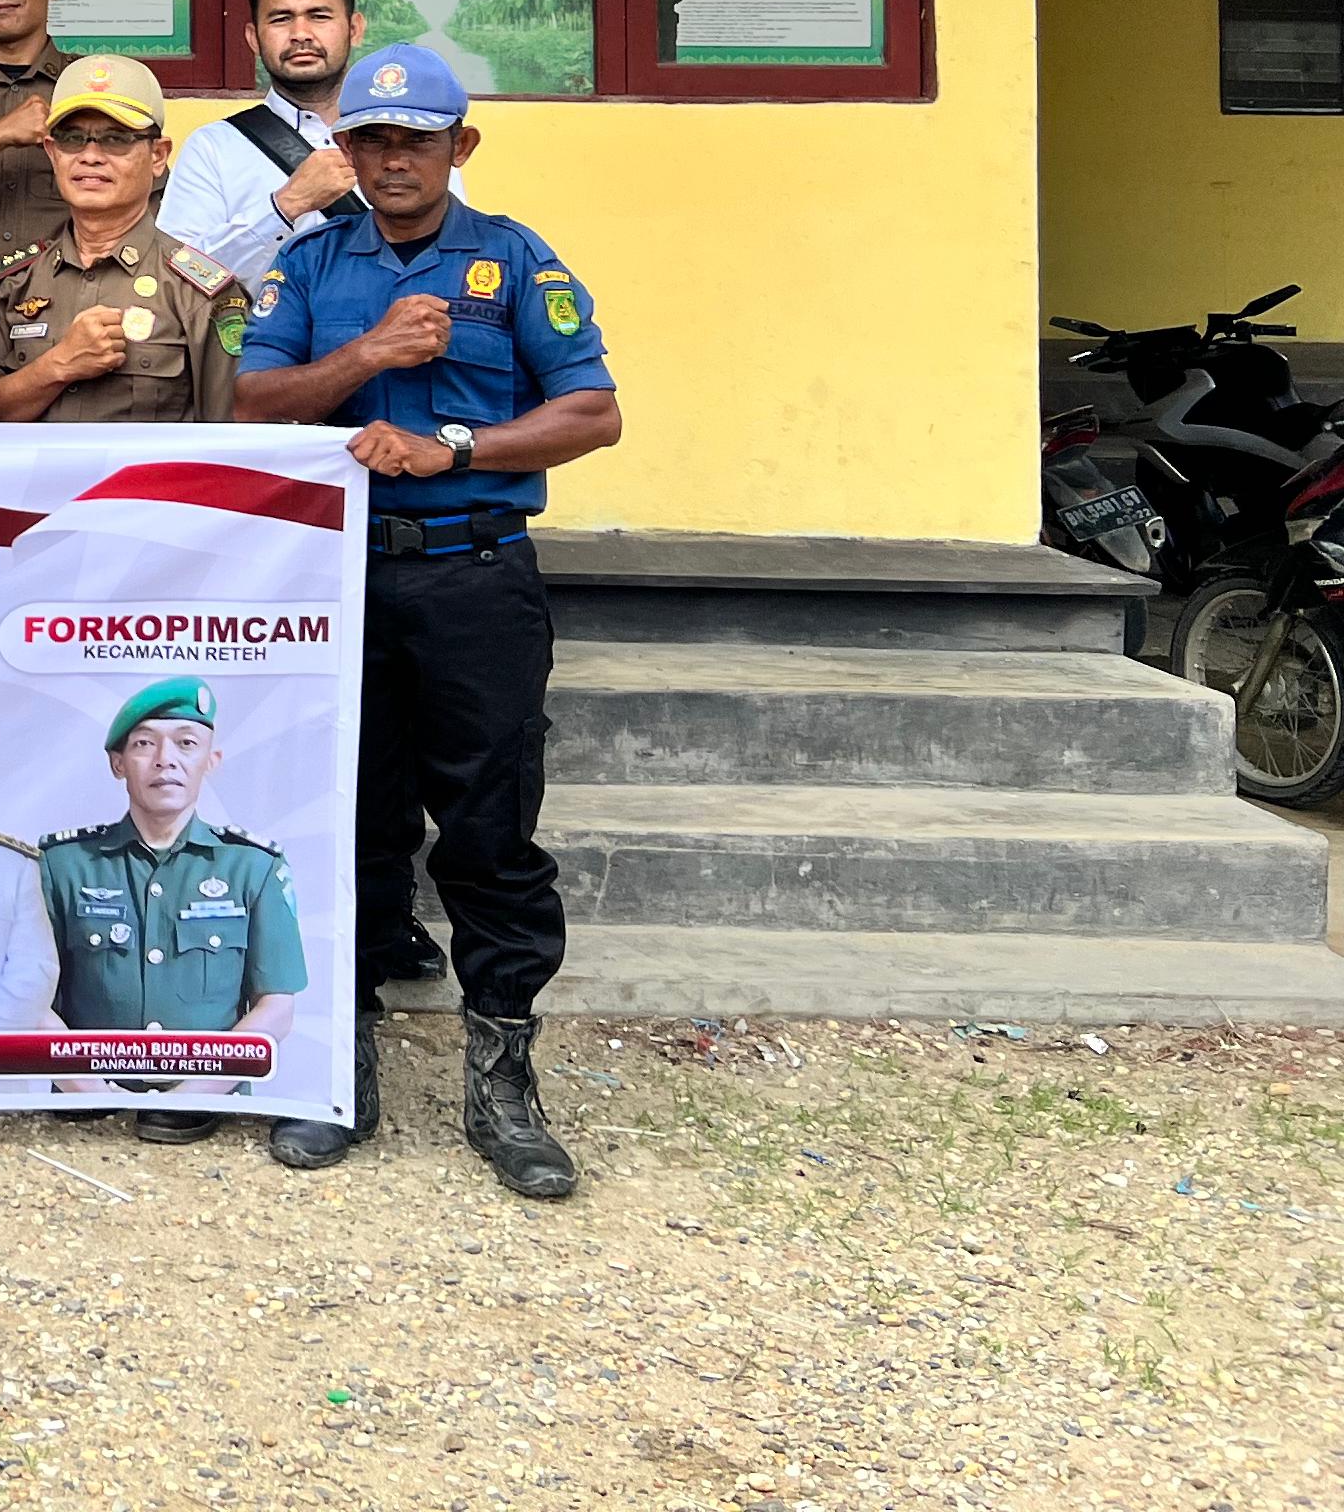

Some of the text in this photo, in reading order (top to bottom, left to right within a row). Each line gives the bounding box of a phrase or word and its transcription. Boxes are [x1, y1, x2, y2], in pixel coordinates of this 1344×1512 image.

[24, 615, 330, 643] FORKOPIMCAM
[84, 645, 267, 661] KECAMATAN RETEH
[50, 1042, 267, 1059] KAPTEN(Arh) BUDI SANDORO
[90, 1059, 222, 1072] DANRAMIL 07 RETEH
